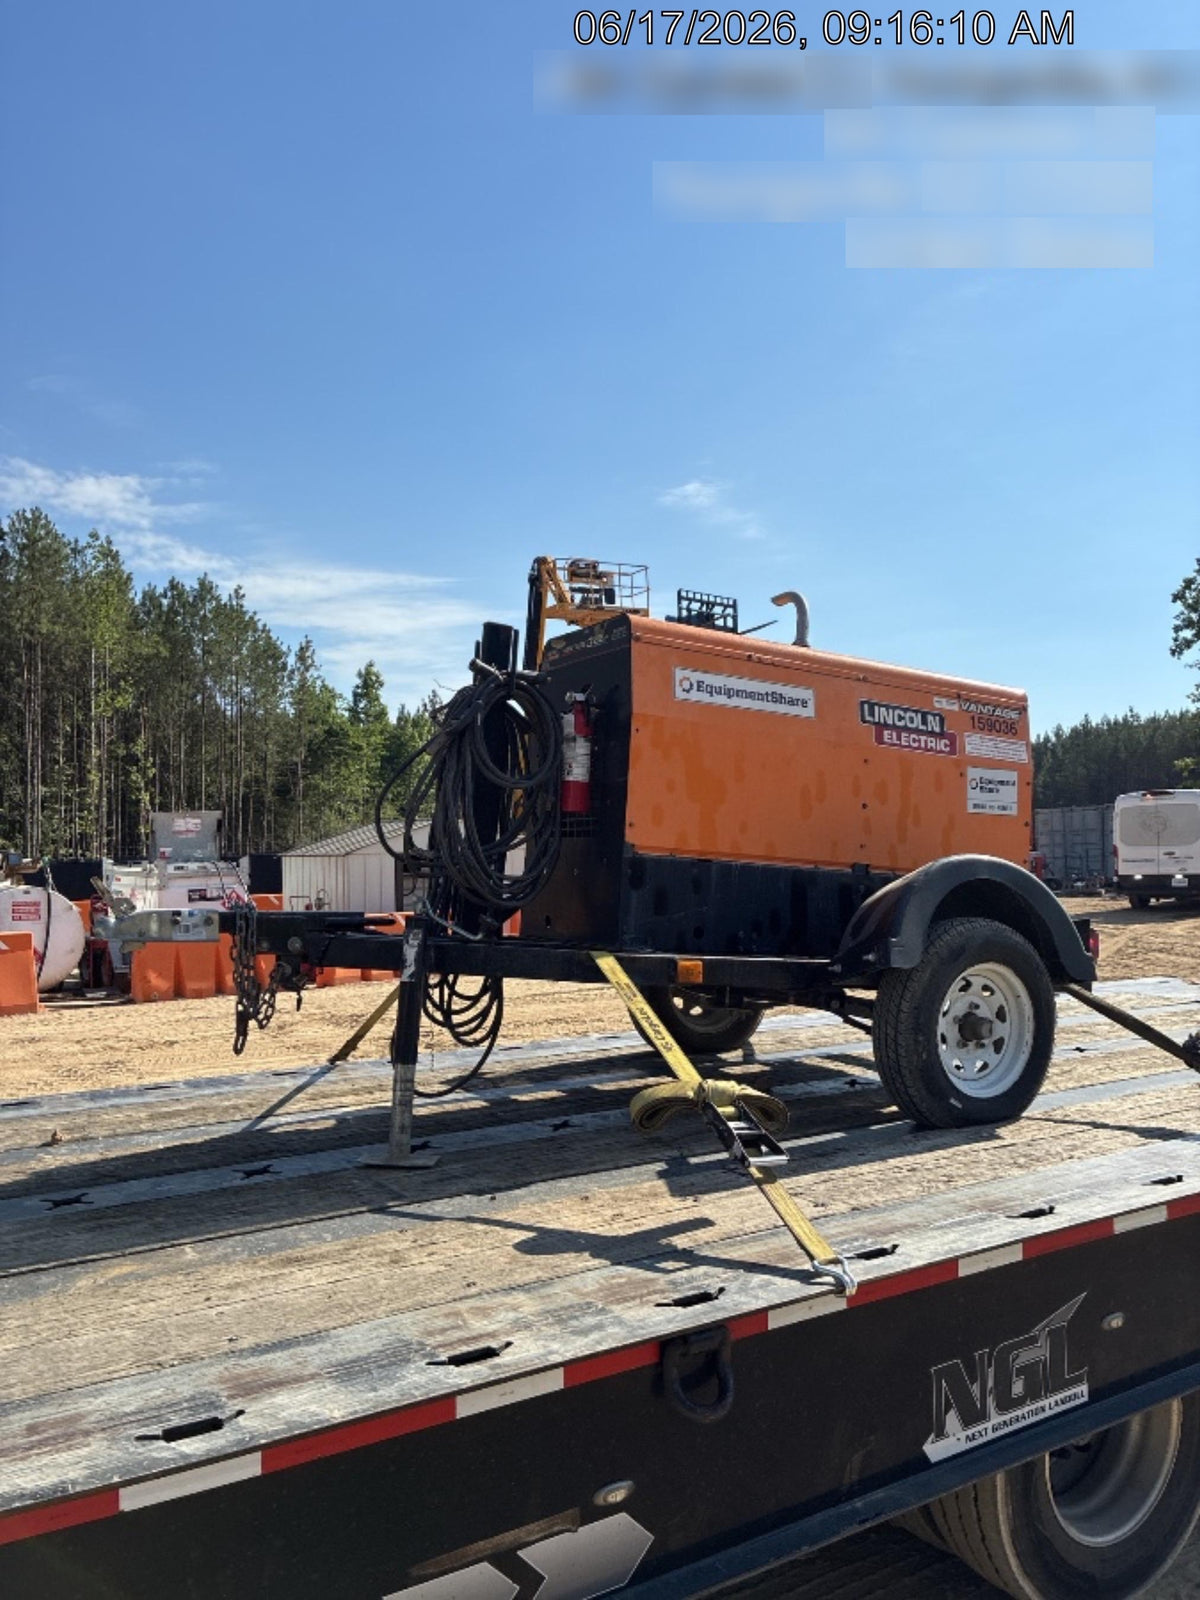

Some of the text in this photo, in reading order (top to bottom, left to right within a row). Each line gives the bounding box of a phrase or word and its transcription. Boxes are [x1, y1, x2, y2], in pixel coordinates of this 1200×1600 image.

[696, 680, 808, 708] EquipmentShare
[863, 703, 941, 733] LINCOLN
[961, 701, 1021, 719] VANTAGE
[970, 714, 1019, 736] 159036
[883, 730, 951, 752] ELECTRIC
[930, 1321, 1088, 1444] NGL
[964, 1429, 989, 1445] NEXT
[991, 1404, 1047, 1434] GENERATION
